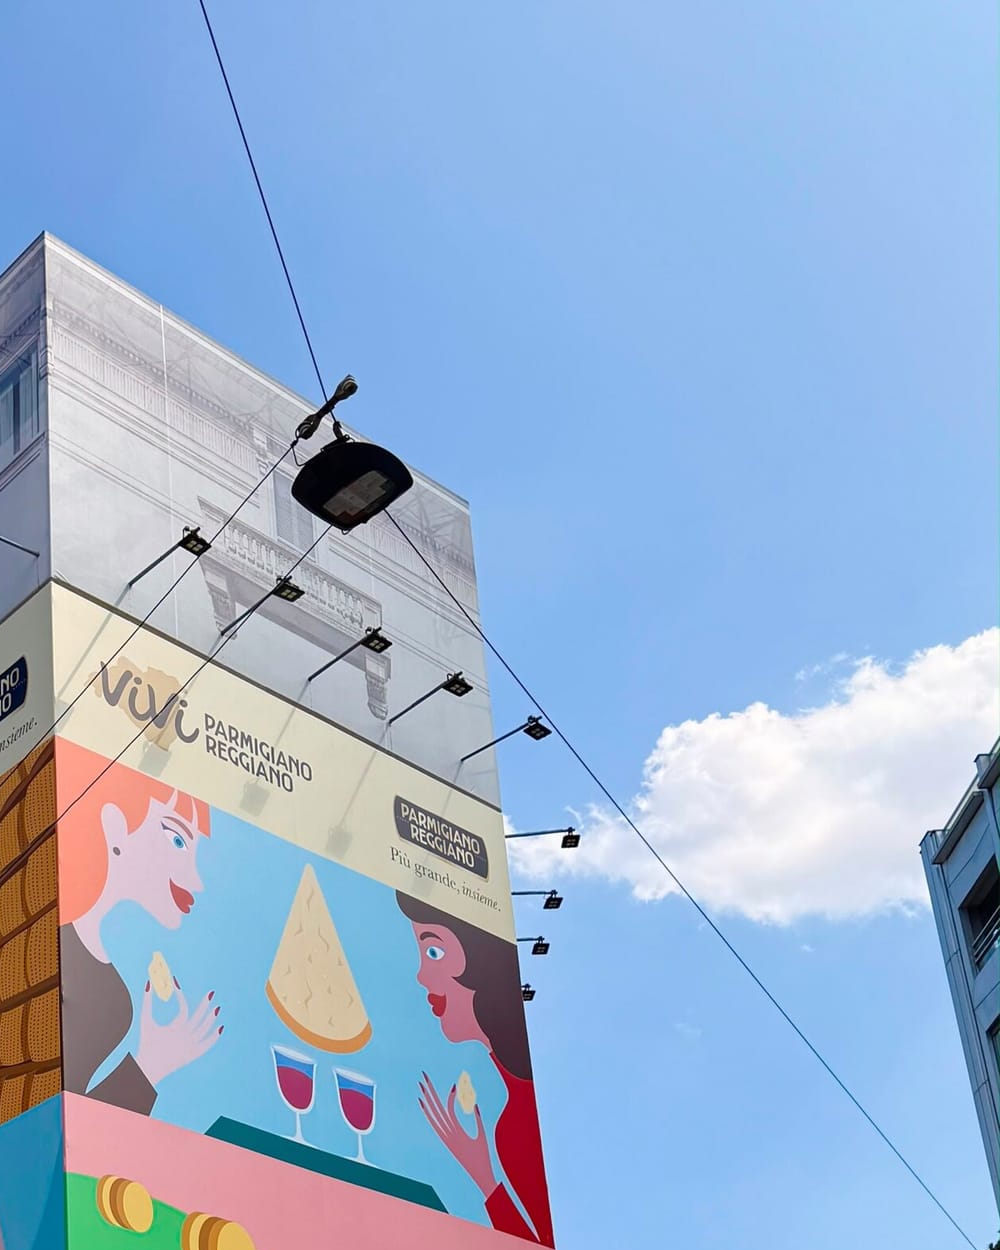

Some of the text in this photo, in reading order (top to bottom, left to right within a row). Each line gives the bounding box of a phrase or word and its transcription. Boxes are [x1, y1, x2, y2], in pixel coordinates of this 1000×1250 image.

[204, 713, 313, 782] PARMIGIANO
[206, 737, 294, 793] REGGIANO
[400, 803, 480, 855] PARMIGIANO
[410, 823, 474, 867] REGGIANO
[391, 847, 502, 912] Più grande, insieme.
